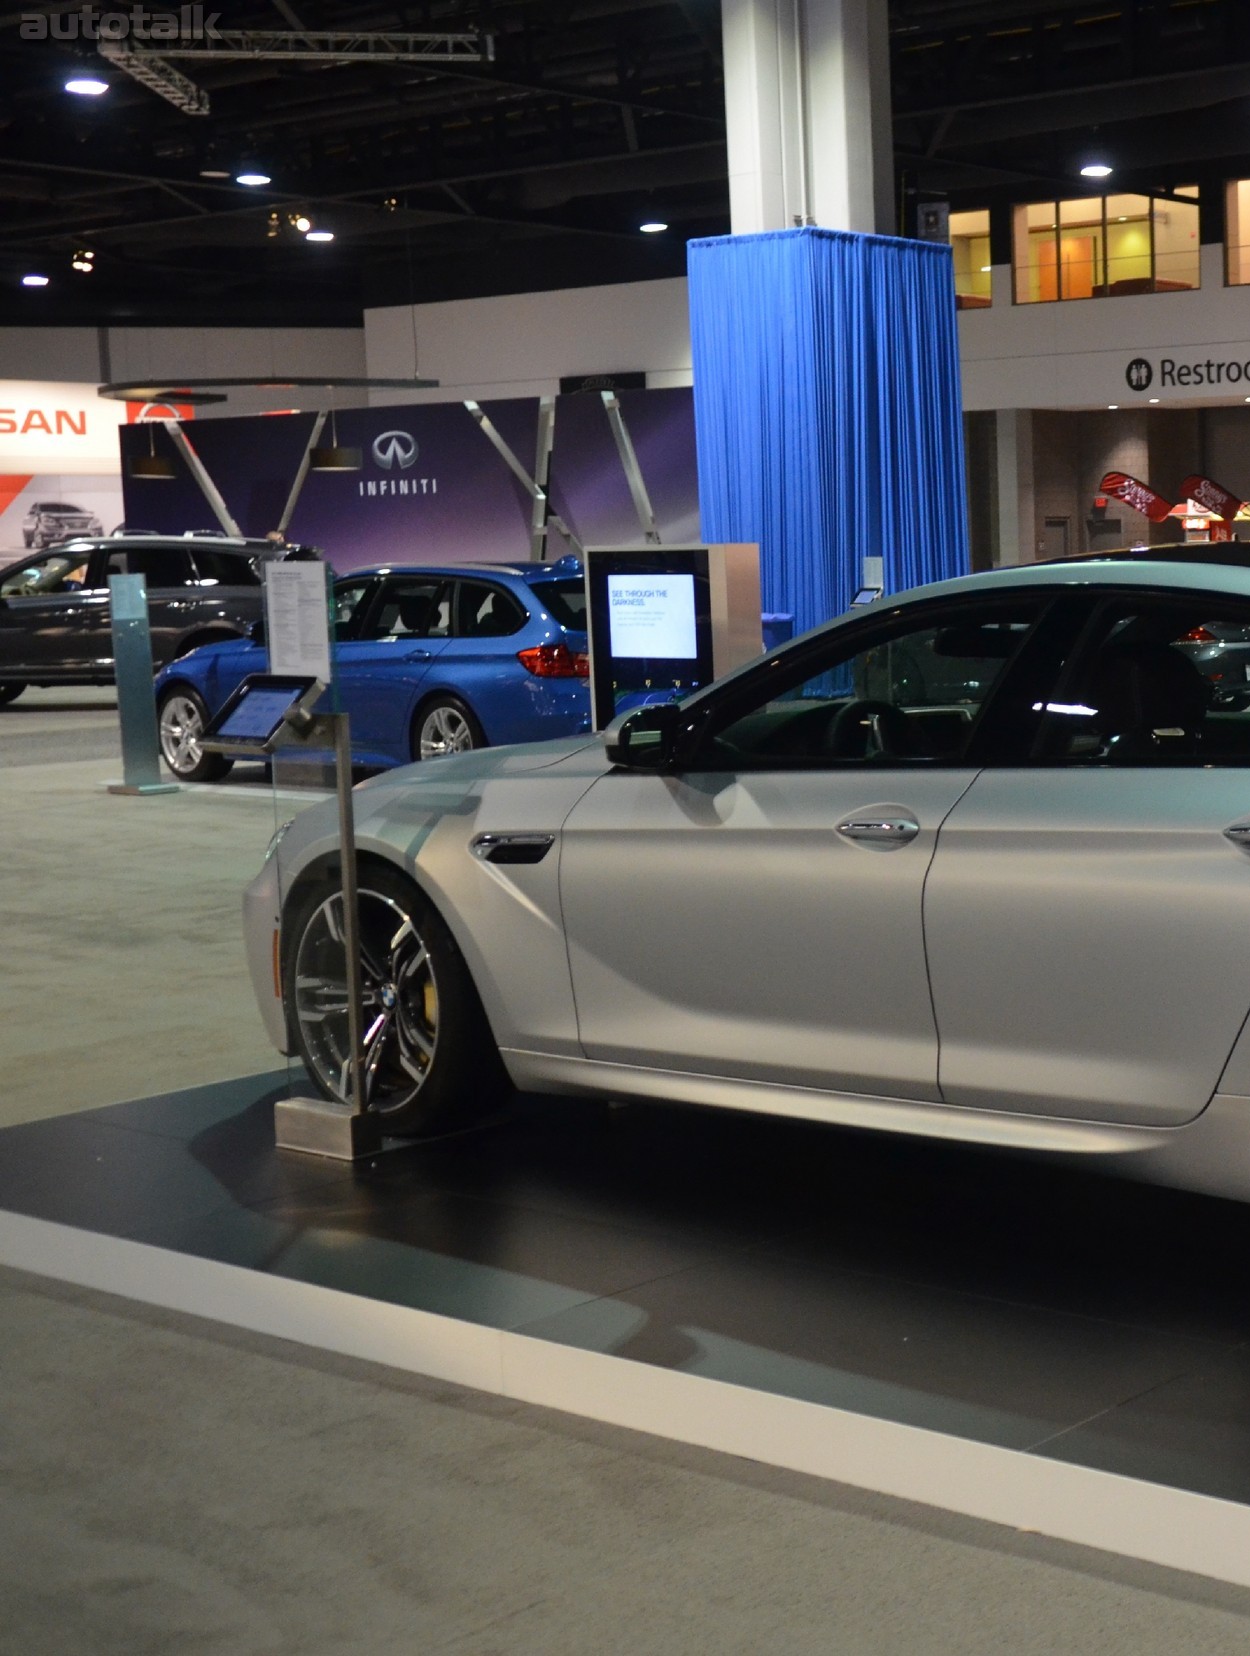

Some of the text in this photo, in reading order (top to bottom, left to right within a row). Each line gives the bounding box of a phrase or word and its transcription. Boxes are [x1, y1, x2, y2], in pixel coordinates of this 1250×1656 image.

[359, 478, 437, 496] INFINITI
[612, 590, 668, 598] SEE THROUGH THE
